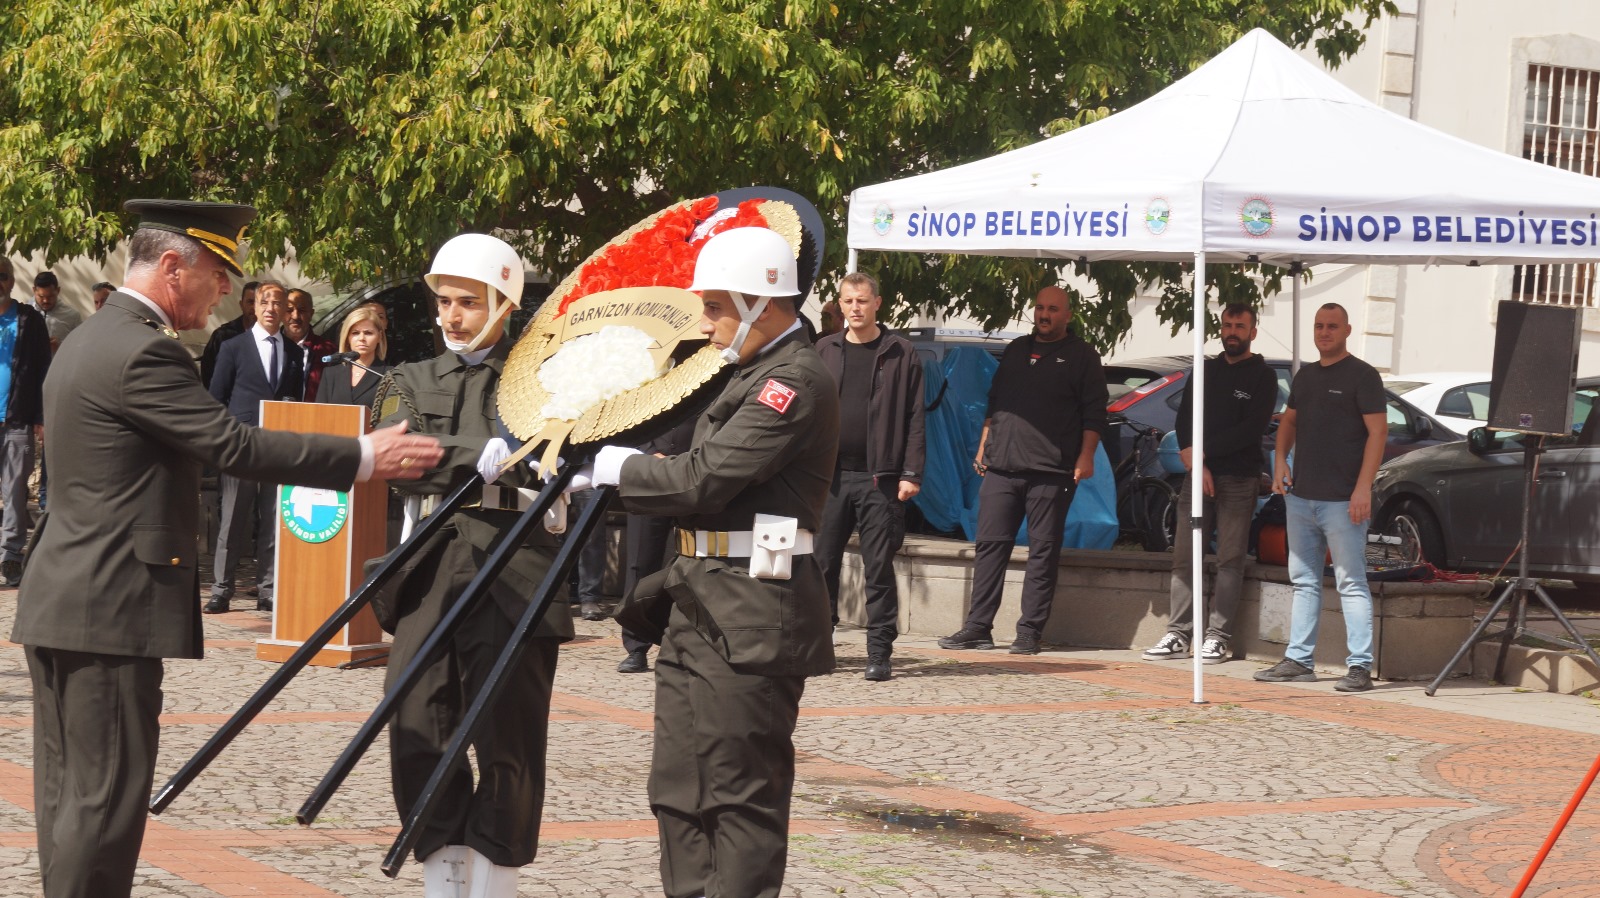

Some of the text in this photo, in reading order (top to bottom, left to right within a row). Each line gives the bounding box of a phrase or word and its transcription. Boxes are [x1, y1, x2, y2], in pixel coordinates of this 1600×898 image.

[908, 203, 1128, 237] SİNOP BELEDİYESİ
[1298, 207, 1597, 246] SİNOP BELEDİYESİ
[570, 302, 693, 331] GARNİZON KOMUTANLIĞI
